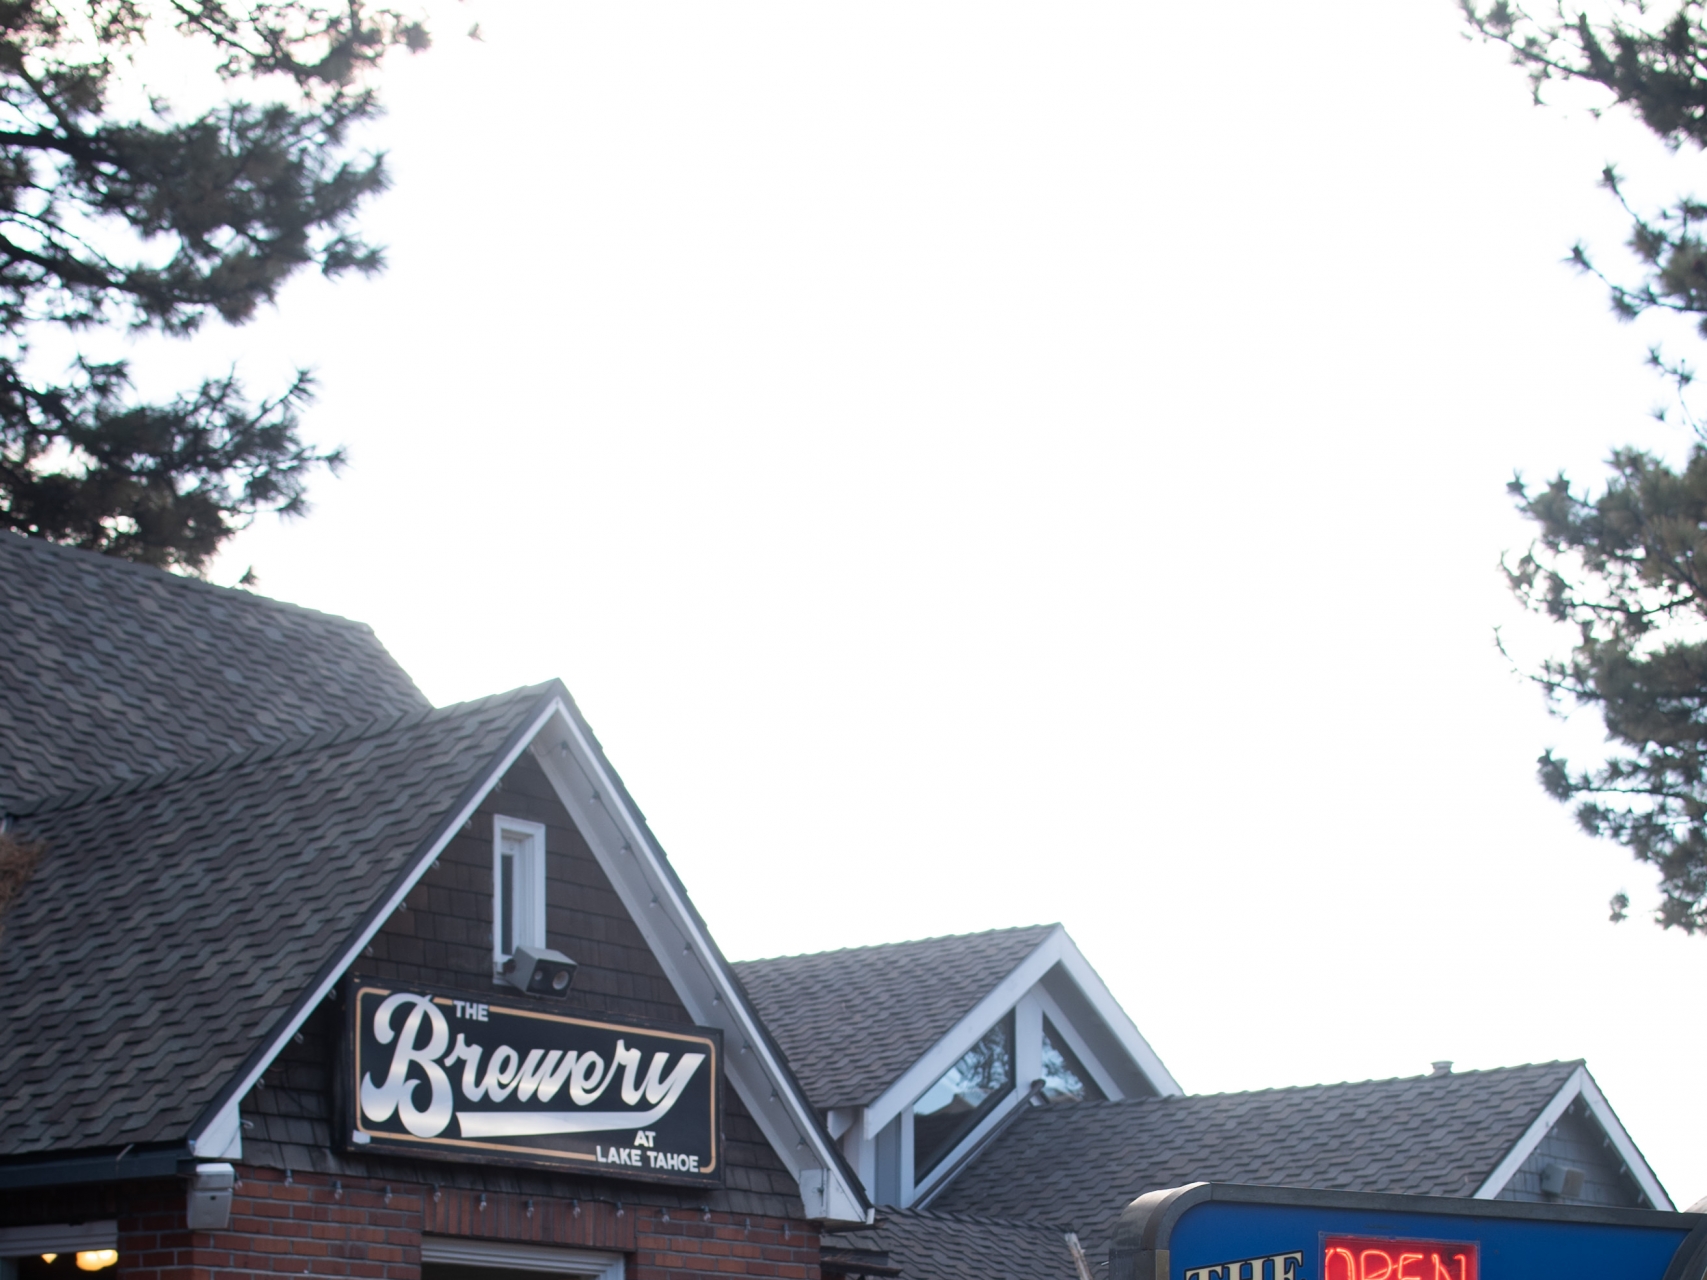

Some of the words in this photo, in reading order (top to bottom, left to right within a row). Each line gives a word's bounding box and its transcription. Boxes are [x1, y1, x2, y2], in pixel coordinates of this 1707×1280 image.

[453, 1000, 489, 1022] THE
[360, 992, 706, 1138] Brewery
[633, 1129, 656, 1148] AT
[596, 1145, 642, 1167] LAKE
[646, 1151, 699, 1173] TAHOE
